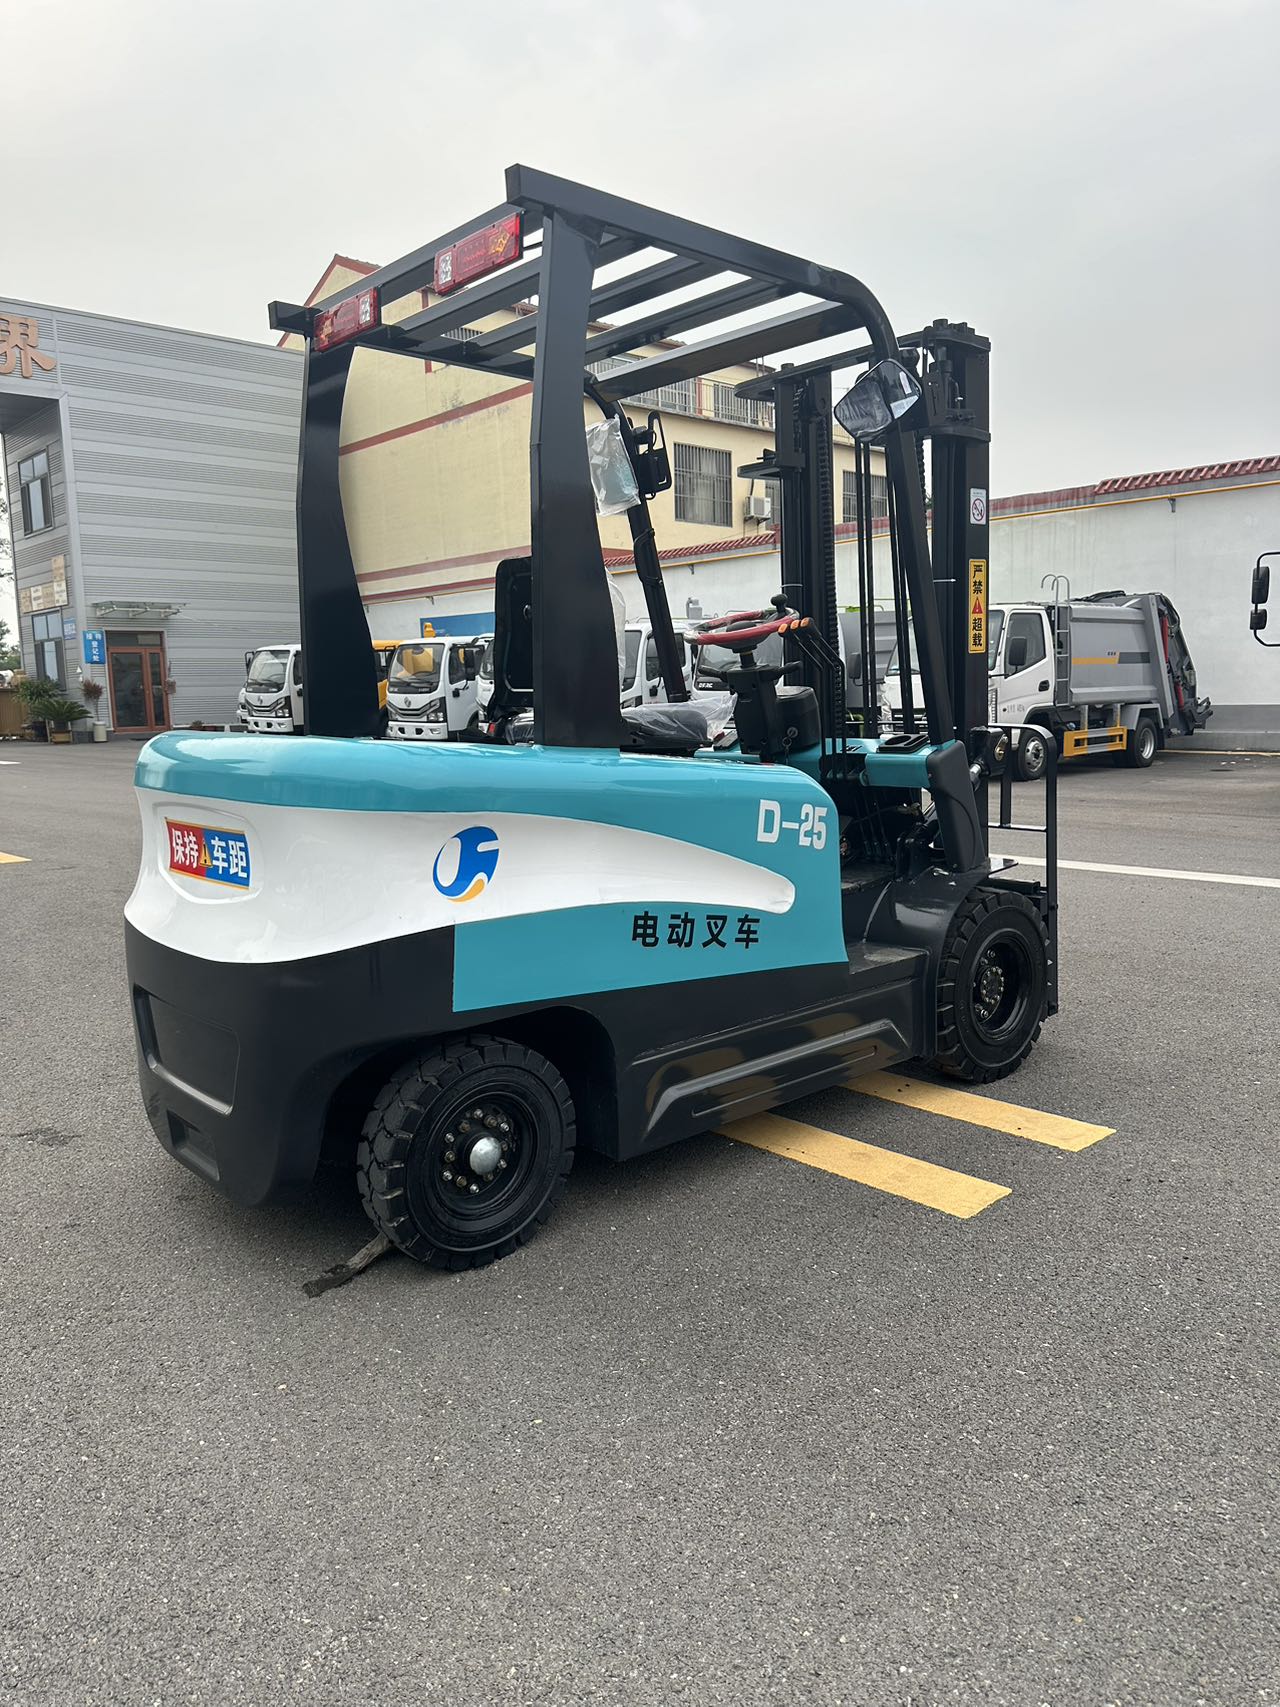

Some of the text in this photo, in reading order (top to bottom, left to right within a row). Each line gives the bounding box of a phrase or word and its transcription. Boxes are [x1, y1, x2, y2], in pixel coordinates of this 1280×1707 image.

[972, 564, 983, 647] 严禁超载
[756, 799, 828, 850] D-25
[171, 828, 248, 878] 保持车距
[631, 911, 761, 949] 电动叉车
